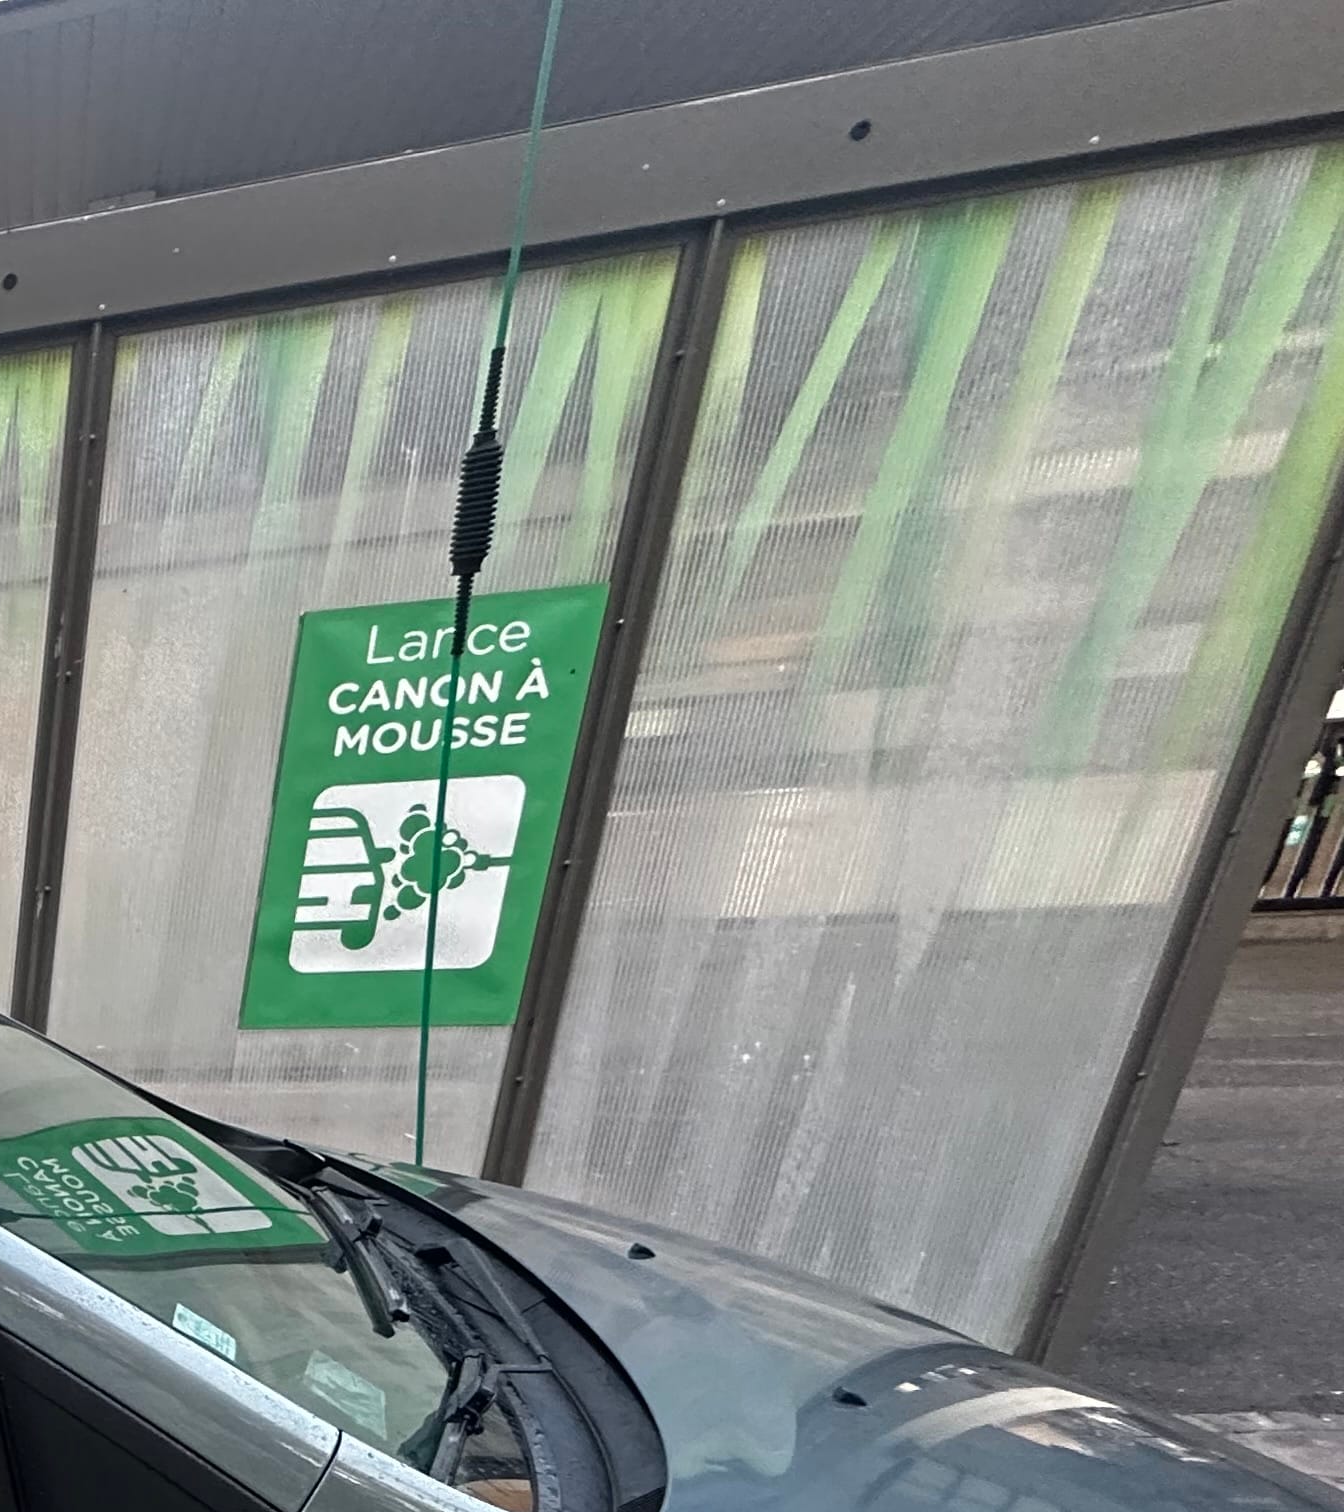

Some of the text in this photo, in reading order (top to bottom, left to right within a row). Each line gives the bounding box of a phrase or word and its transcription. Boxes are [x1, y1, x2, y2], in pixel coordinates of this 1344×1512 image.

[328, 657, 550, 715] CANON À
[333, 712, 531, 757] MOUSSE
